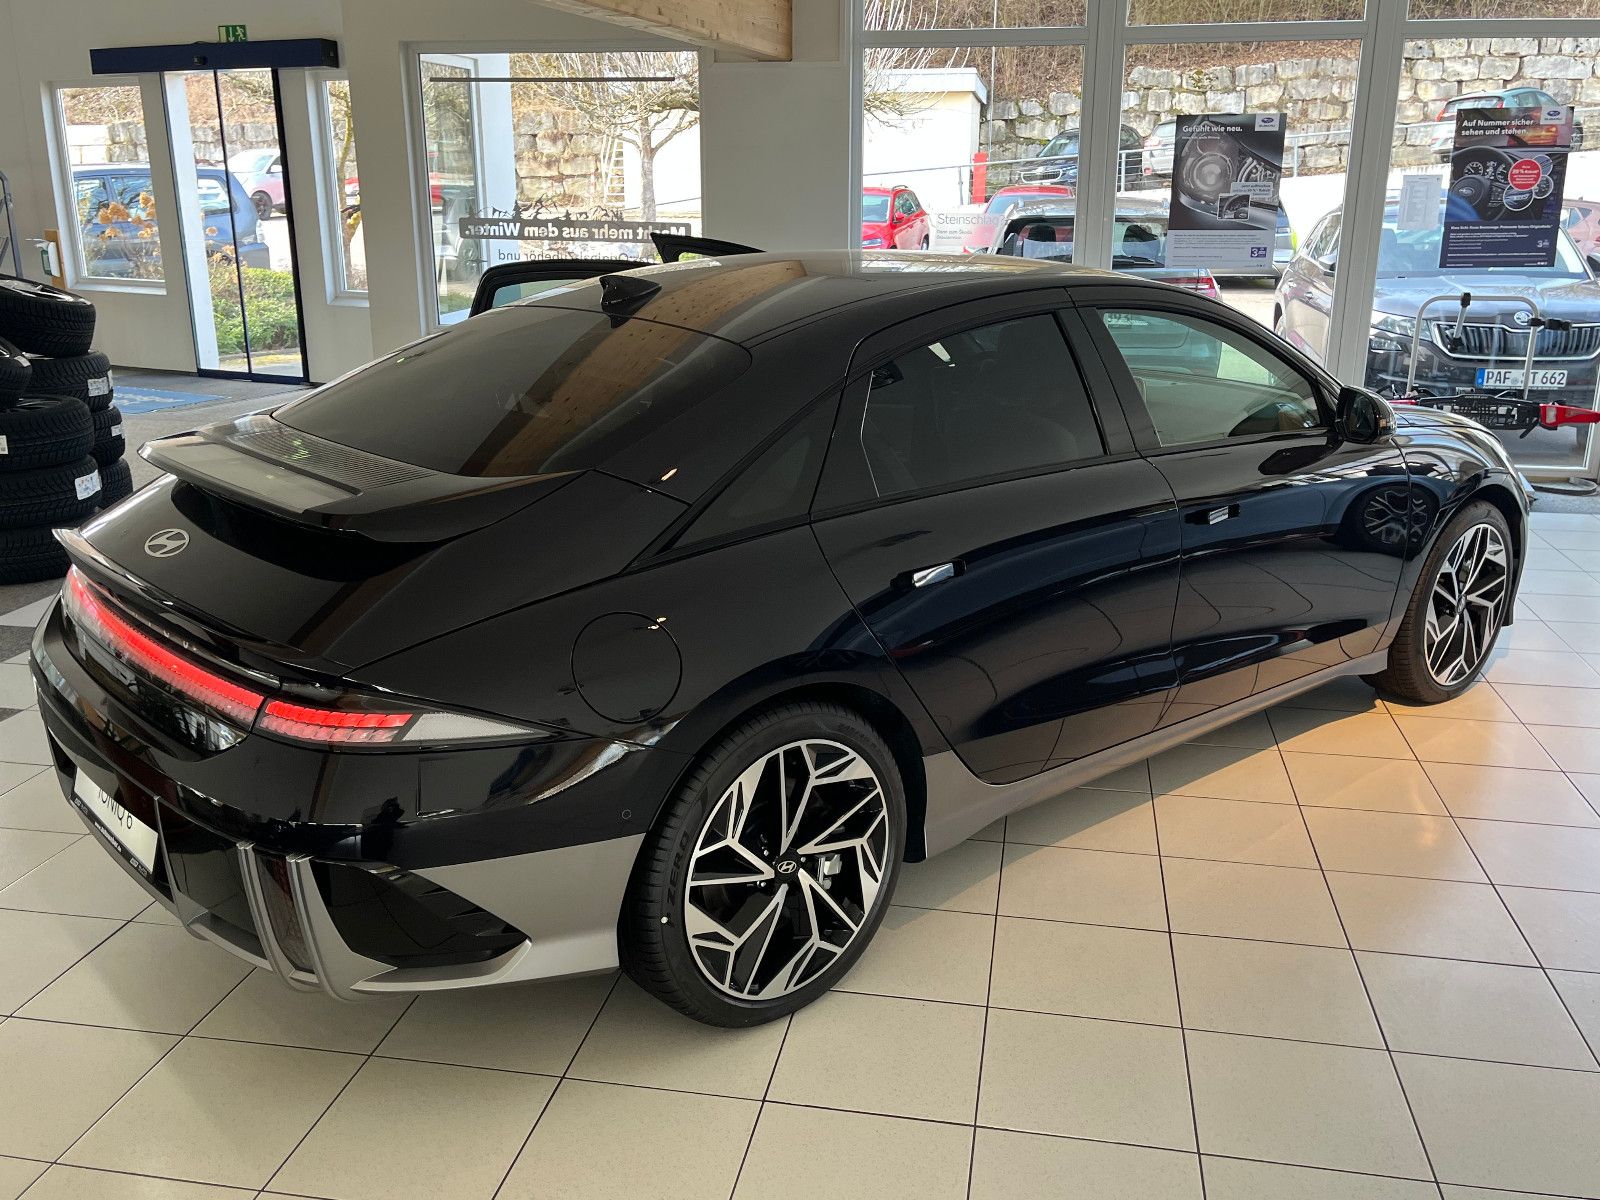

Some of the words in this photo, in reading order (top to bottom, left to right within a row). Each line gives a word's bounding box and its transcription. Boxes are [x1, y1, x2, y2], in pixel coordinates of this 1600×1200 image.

[1462, 119, 1476, 127] Auf
[1511, 118, 1534, 126] sicher
[1182, 125, 1210, 133] Gefühlt
[1461, 128, 1484, 136] sehen
[1501, 127, 1530, 135] stehen.
[1251, 248, 1258, 256] 3
[1485, 370, 1512, 384] PAF
[1540, 371, 1566, 386] 662
[126, 812, 133, 830] 6
